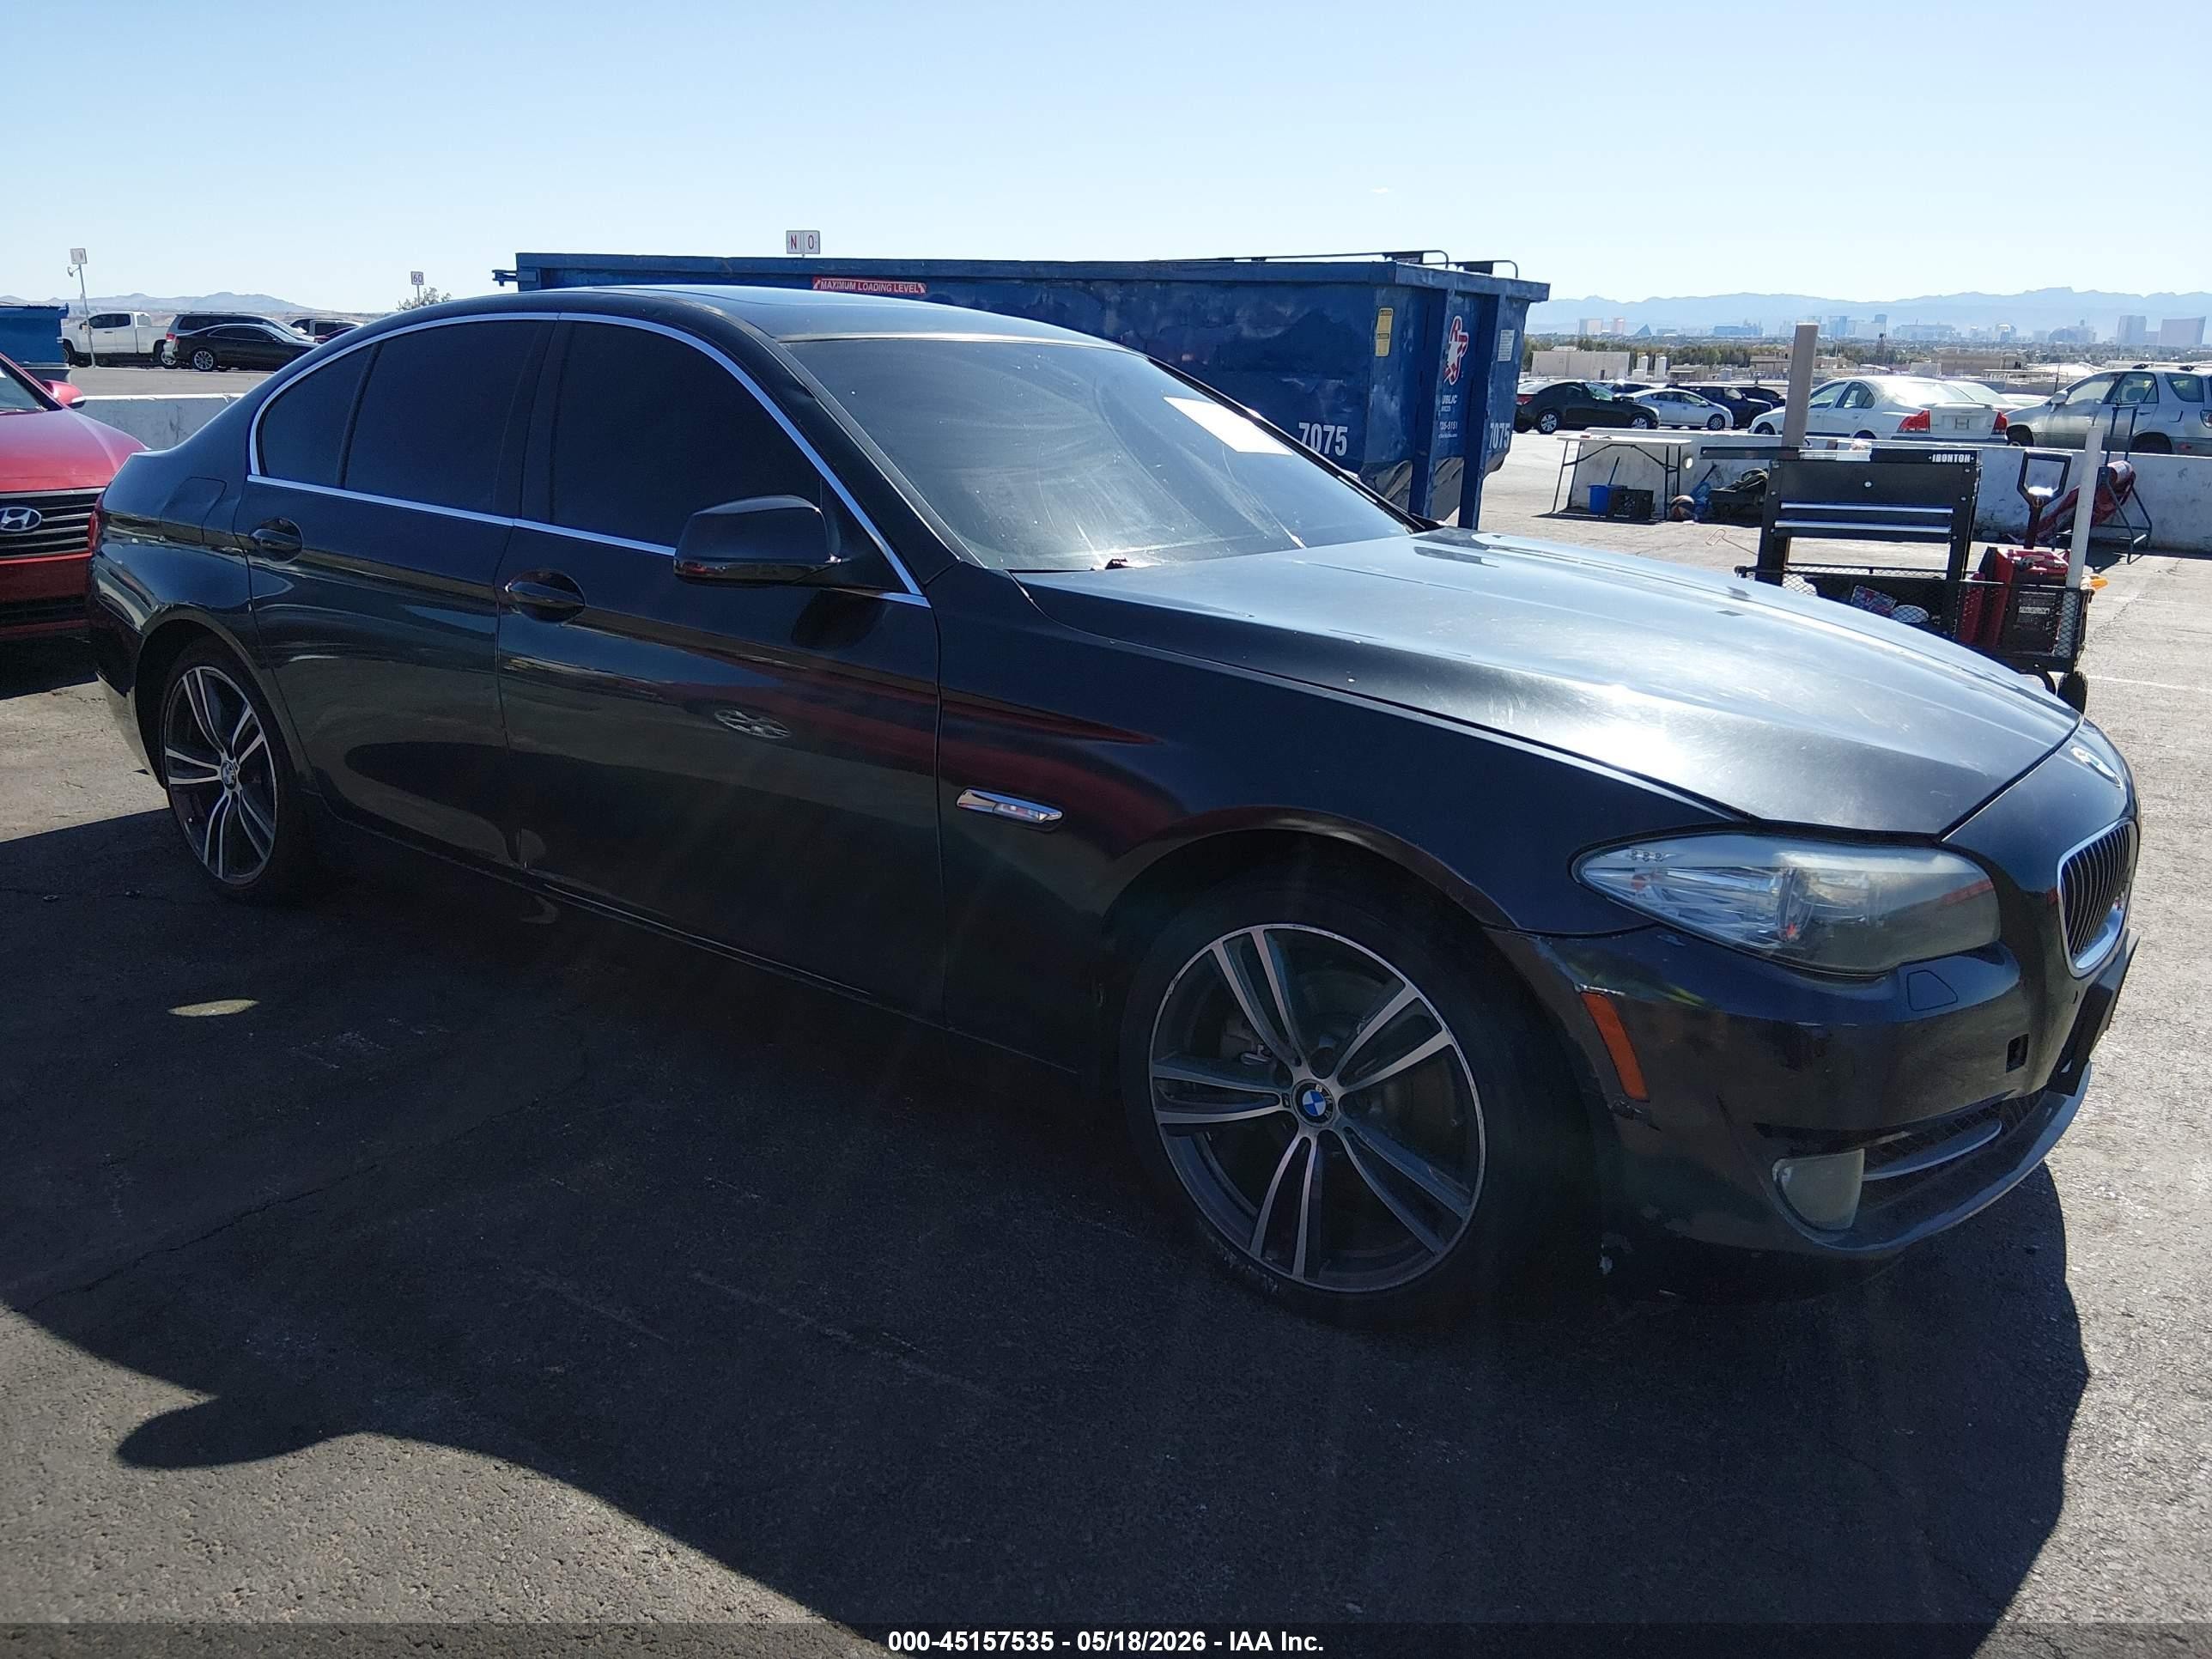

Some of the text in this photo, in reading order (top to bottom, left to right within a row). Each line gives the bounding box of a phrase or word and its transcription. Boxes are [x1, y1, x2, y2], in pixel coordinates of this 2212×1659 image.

[413, 274, 422, 283] 60
[820, 280, 919, 293] MAXIMUM LOADING LEVEL
[1298, 422, 1348, 457] 7075
[1489, 422, 1510, 449] 7075
[1932, 453, 1971, 463] IRONTON
